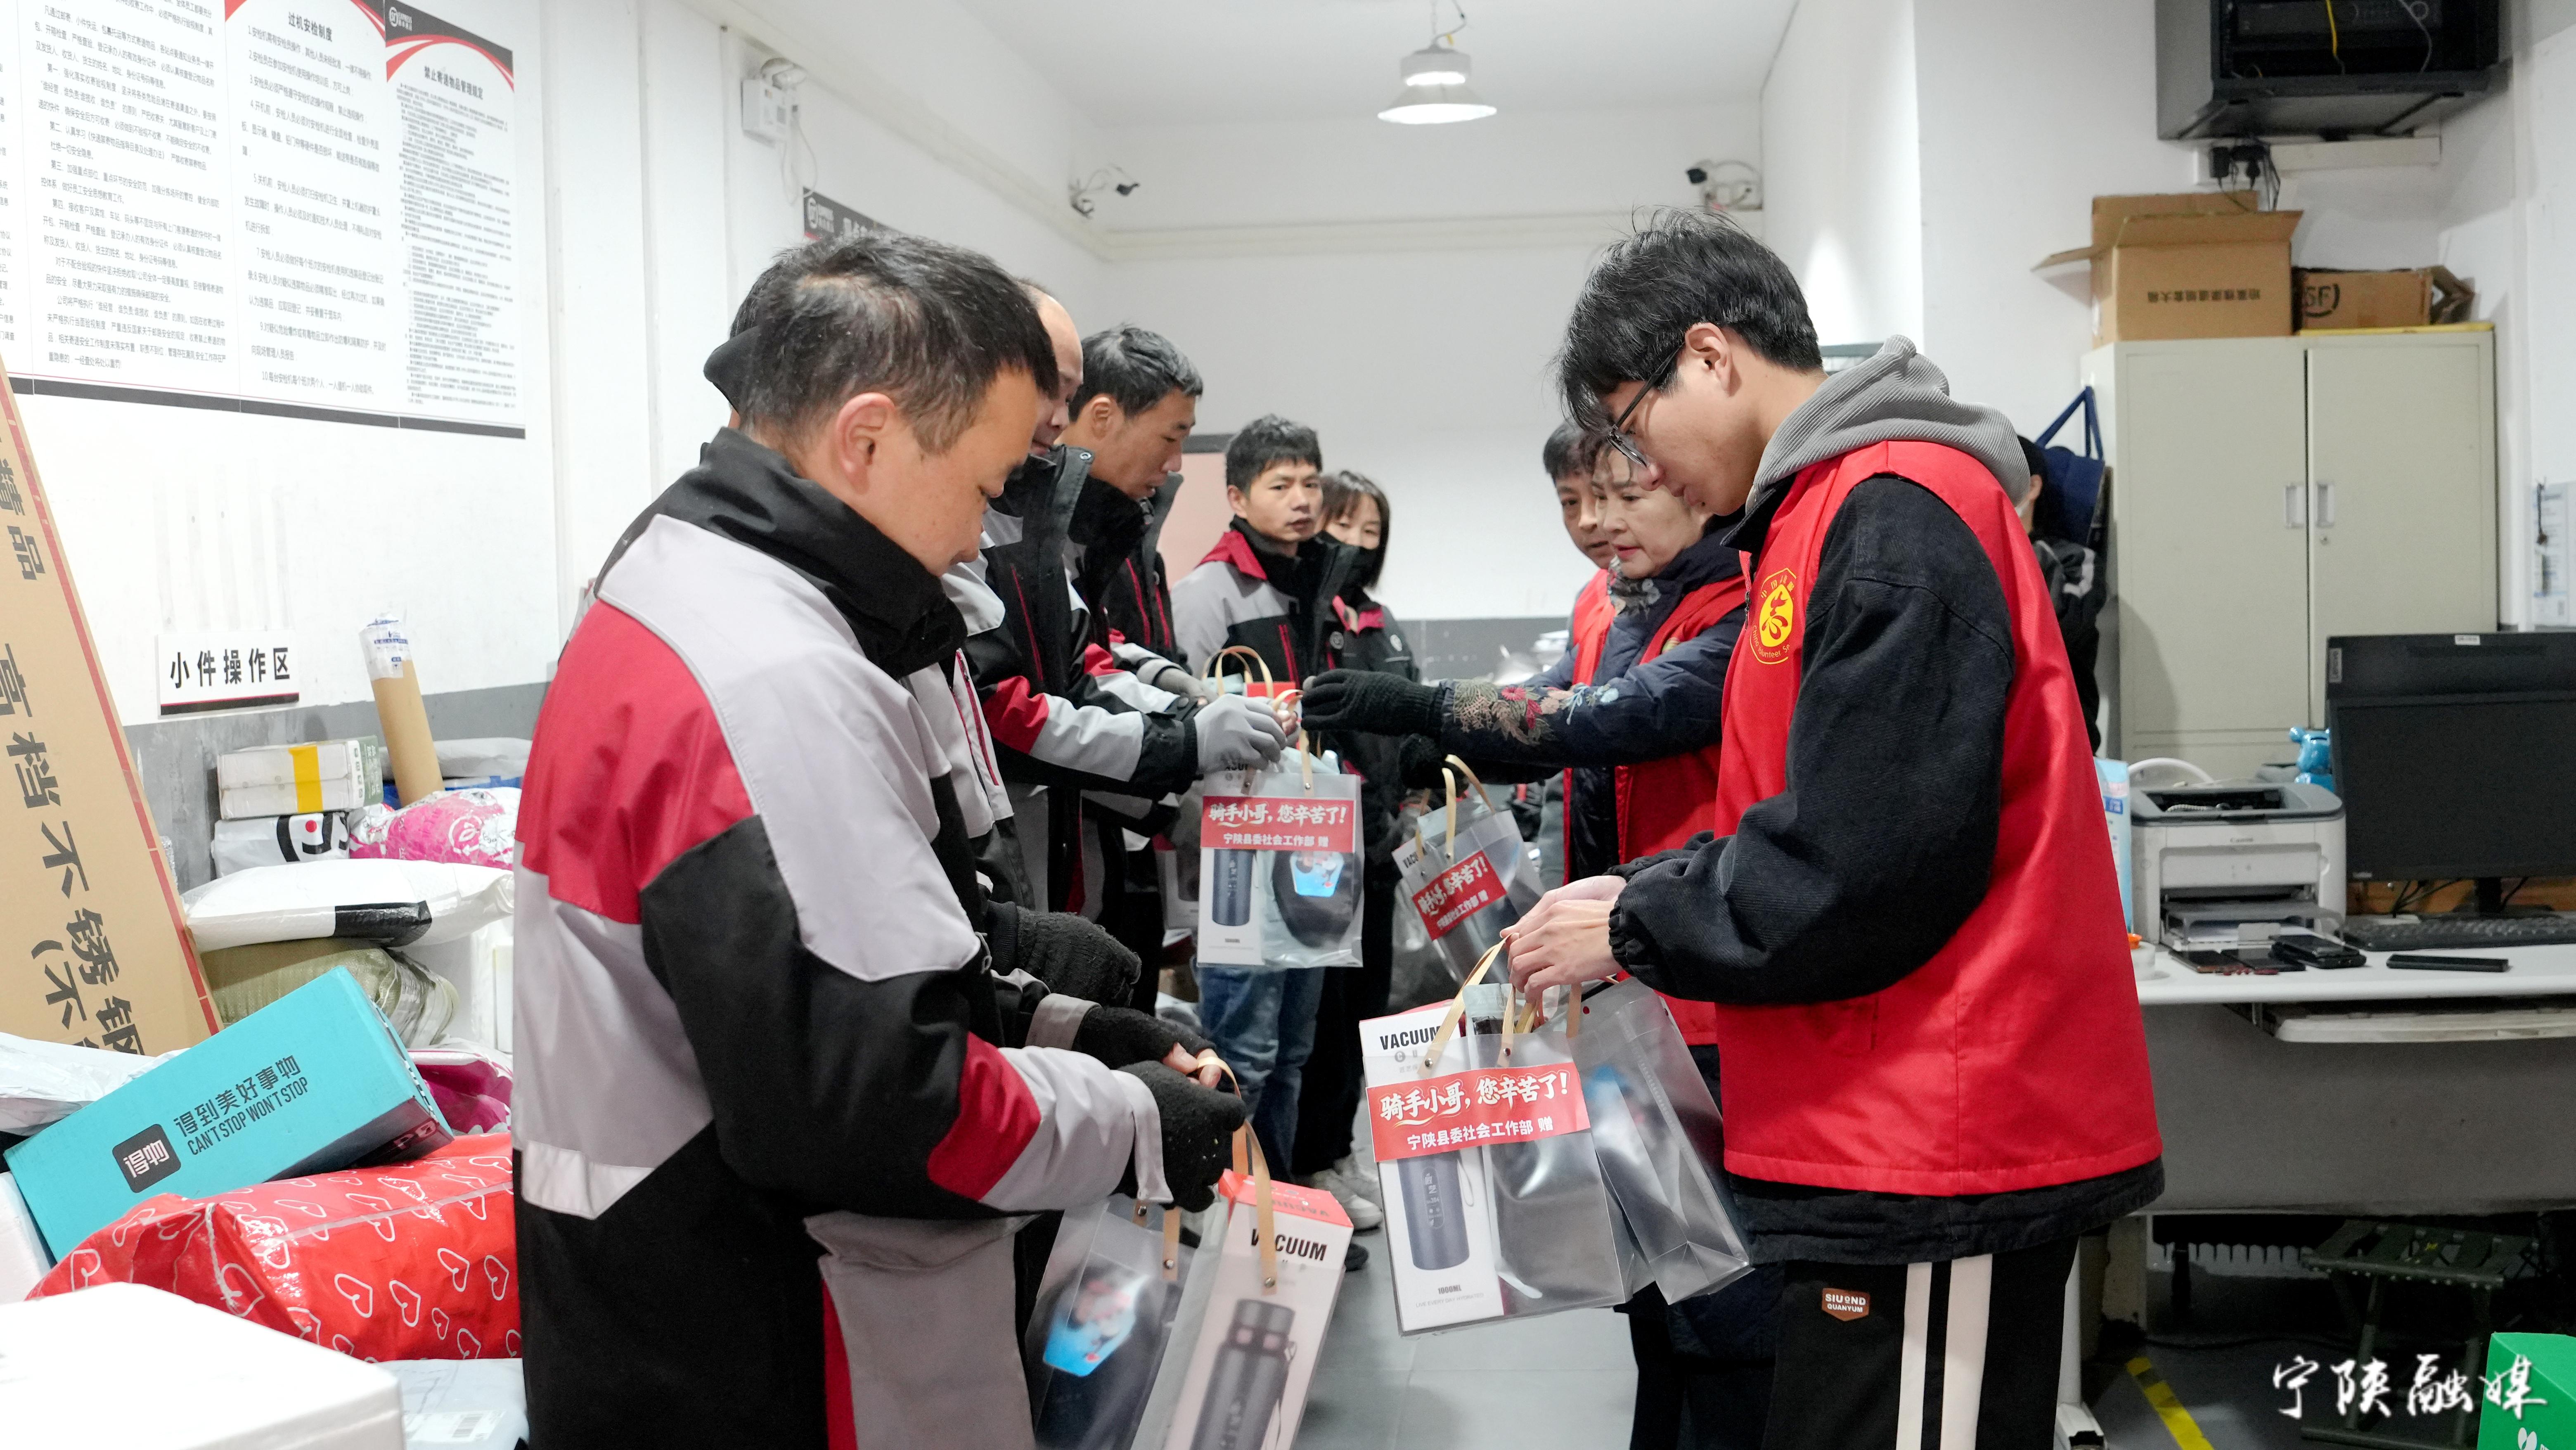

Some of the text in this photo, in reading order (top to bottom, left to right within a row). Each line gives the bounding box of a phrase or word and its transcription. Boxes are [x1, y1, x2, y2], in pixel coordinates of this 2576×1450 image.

[288, 12, 333, 42] 过机安检制度
[170, 647, 290, 689] 小件操作区
[173, 1054, 301, 1137] 得到美好事物
[187, 1076, 308, 1155] CAN'T STOP WON'T STOP
[1407, 1116, 1553, 1150] 宁陕县委社会工作部 赠
[123, 1139, 170, 1178] 得物
[1251, 1228, 1328, 1262] VCUUM
[1437, 1284, 1462, 1295] 1000ML
[1827, 1303, 1863, 1313] QUANYUM
